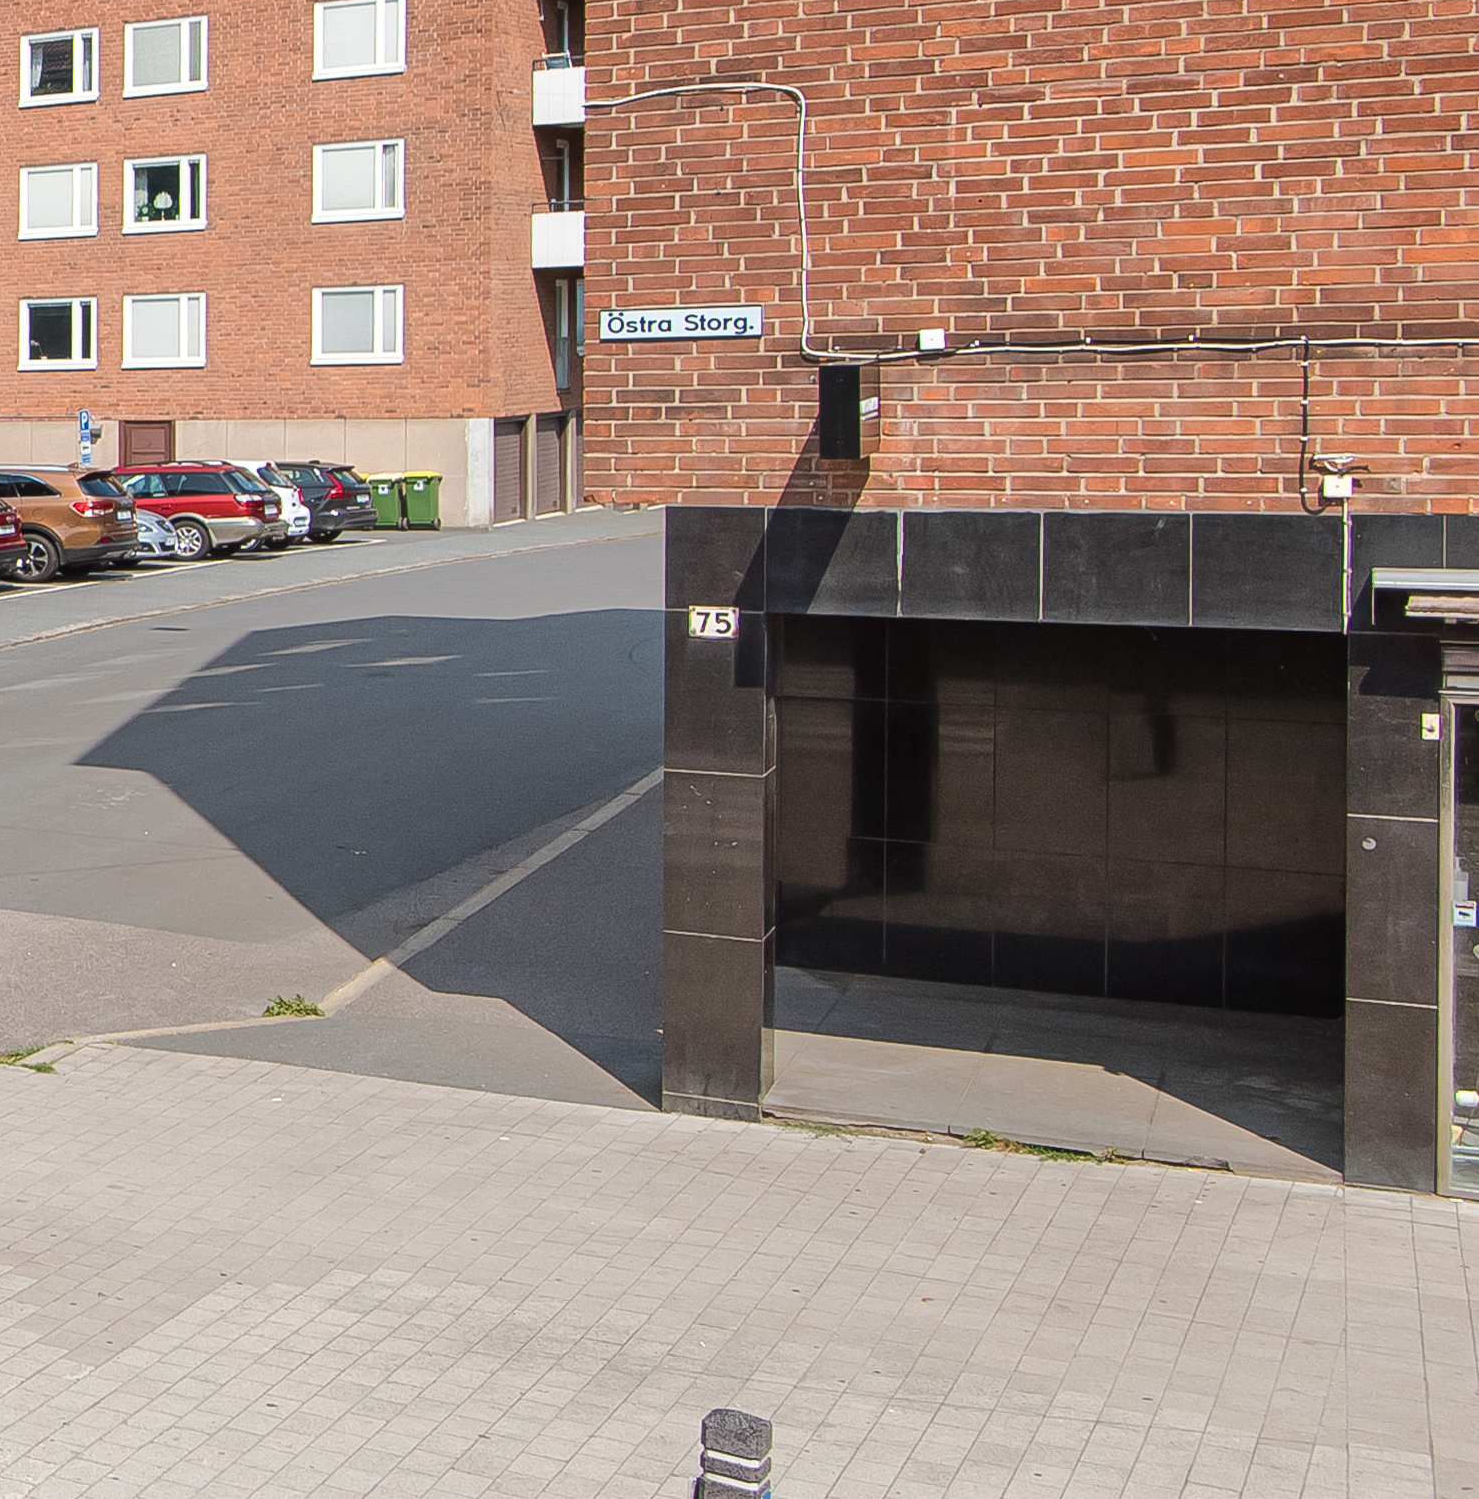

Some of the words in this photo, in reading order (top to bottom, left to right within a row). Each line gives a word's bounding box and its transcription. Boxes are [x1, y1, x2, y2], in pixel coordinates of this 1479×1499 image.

[607, 312, 672, 333] Östra
[684, 314, 754, 335] Storg.
[696, 611, 732, 634] 75
